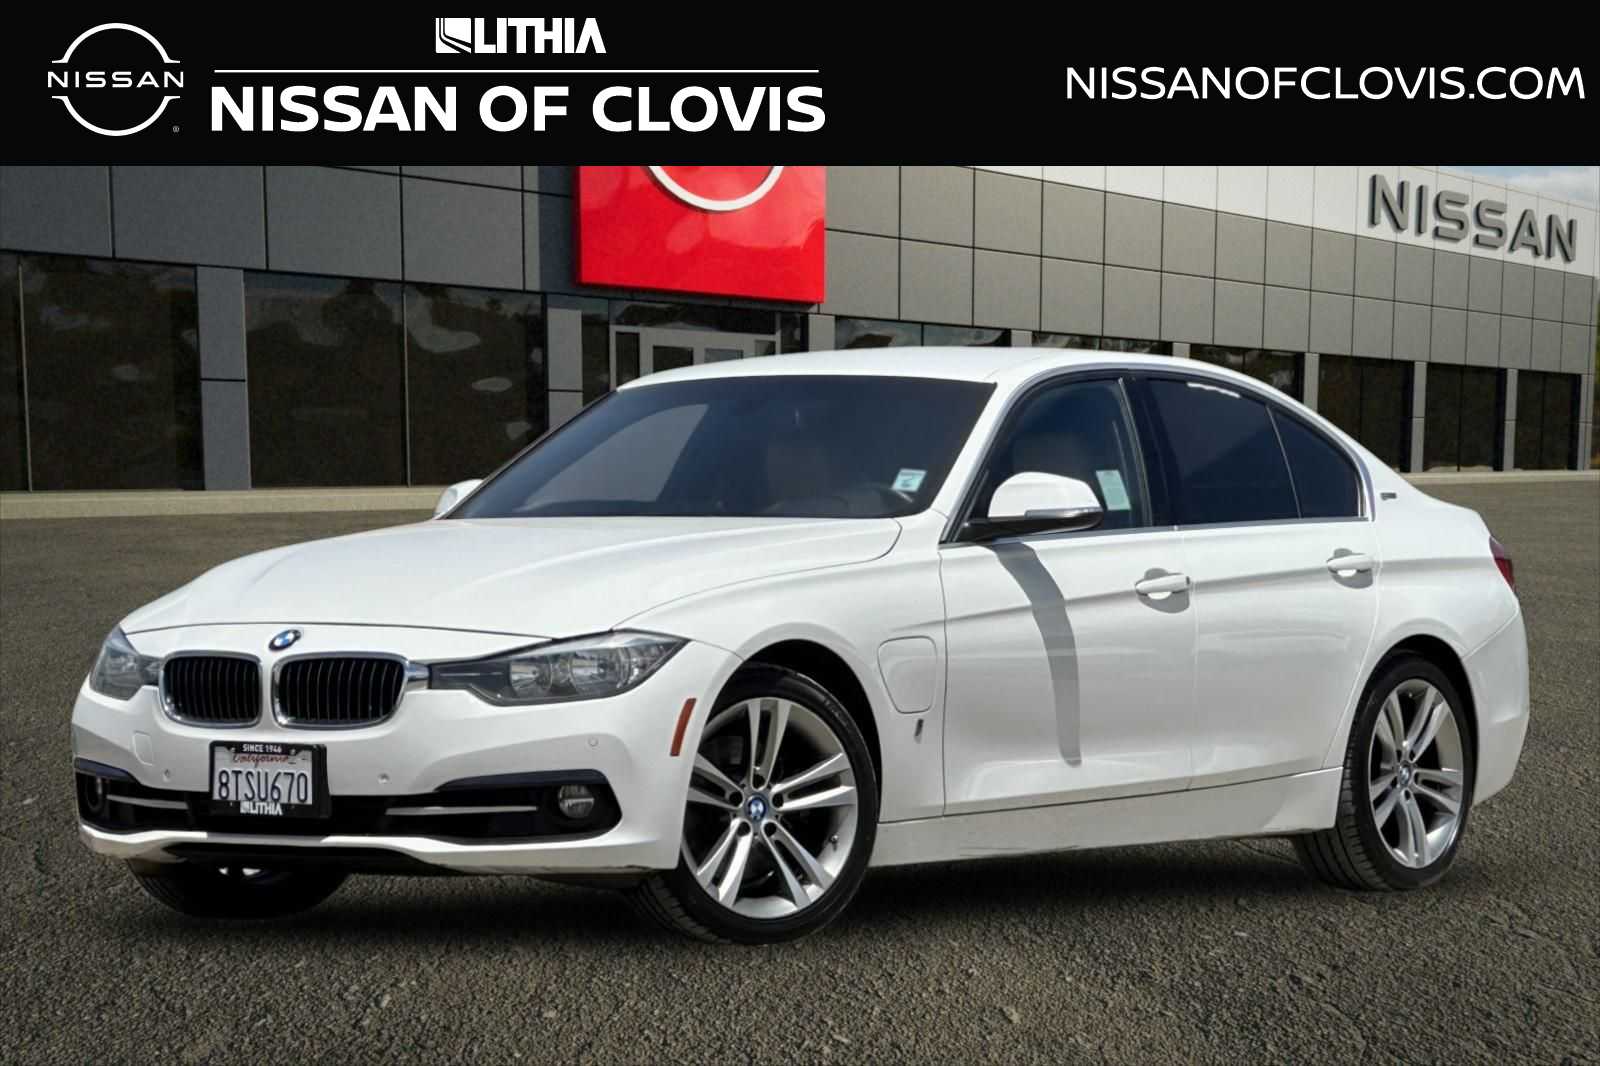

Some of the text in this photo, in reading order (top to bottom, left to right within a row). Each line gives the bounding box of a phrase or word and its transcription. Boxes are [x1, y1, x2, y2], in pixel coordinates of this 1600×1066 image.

[1367, 173, 1578, 263] NISSAN
[242, 744, 264, 753] SINCE
[218, 769, 308, 803] 8TSU670
[250, 802, 283, 816] LITHIA
